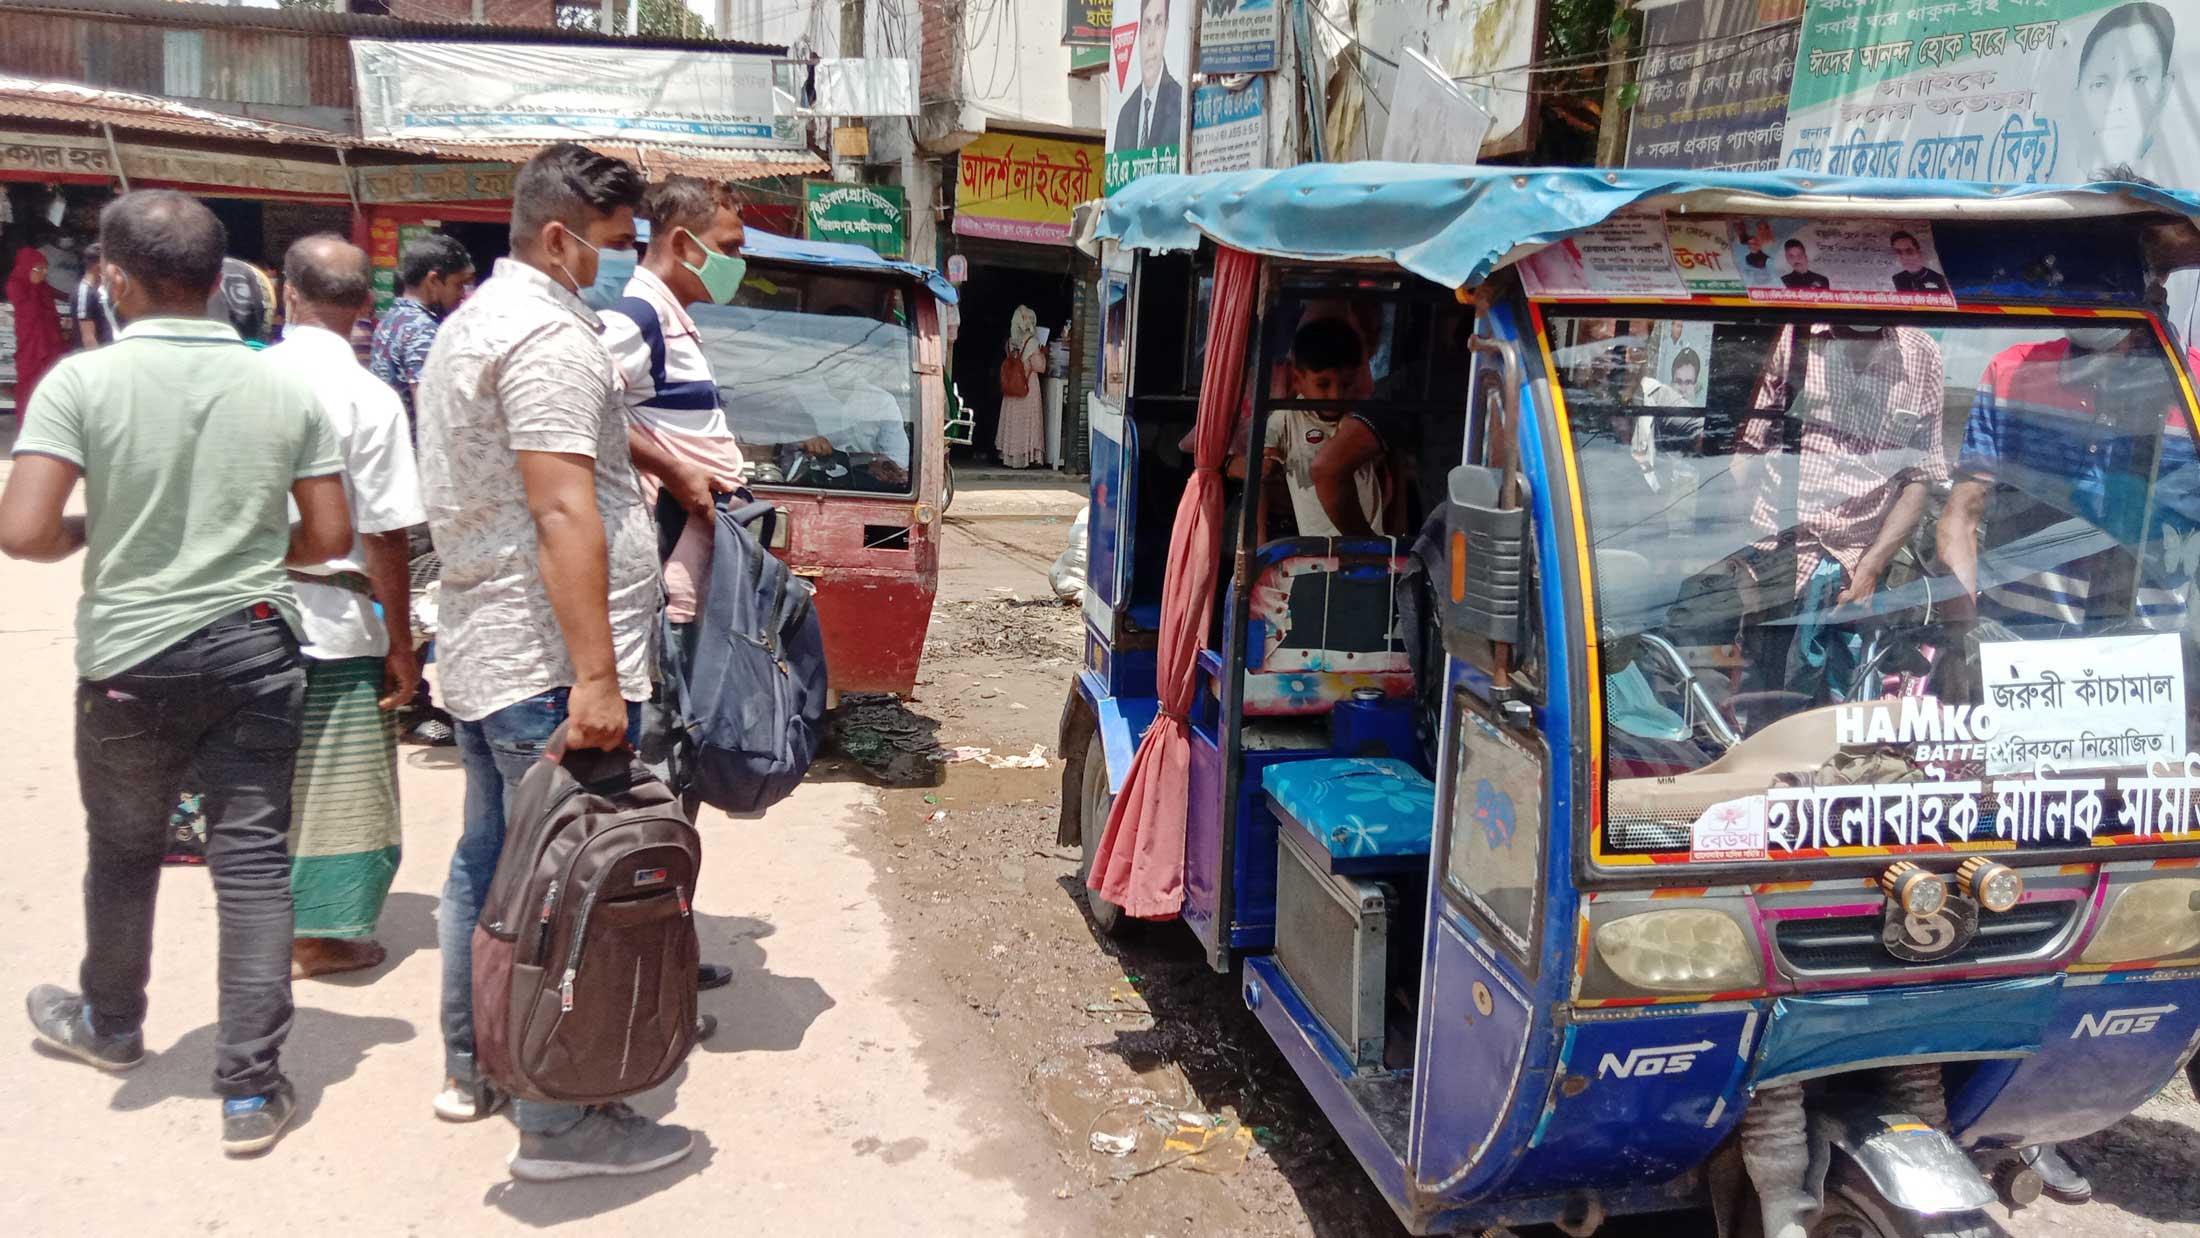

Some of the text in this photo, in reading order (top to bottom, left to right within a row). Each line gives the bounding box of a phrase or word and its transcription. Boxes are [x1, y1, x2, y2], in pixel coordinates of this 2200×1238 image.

[1807, 20, 2060, 78] ঈদের আনন্দ হোক ঘরে বসে
[1648, 140, 1680, 160] সকল
[1684, 134, 1722, 154] প্রকার
[961, 143, 1014, 200] আদর্শ
[1013, 147, 1092, 212] লাইব্রেরী
[1989, 668, 2175, 711] জরুরী কাঁচামাল
[1835, 695, 1999, 744] HAMKO
[2078, 727, 2164, 760] নিয়োজিত
[1768, 762, 1982, 854] হ্যালোবাইক
[1993, 758, 2105, 842] মালিক
[1701, 832, 1760, 848] বেউথা
[2070, 1006, 2166, 1039] NOS
[1598, 1045, 1701, 1080] NOS
